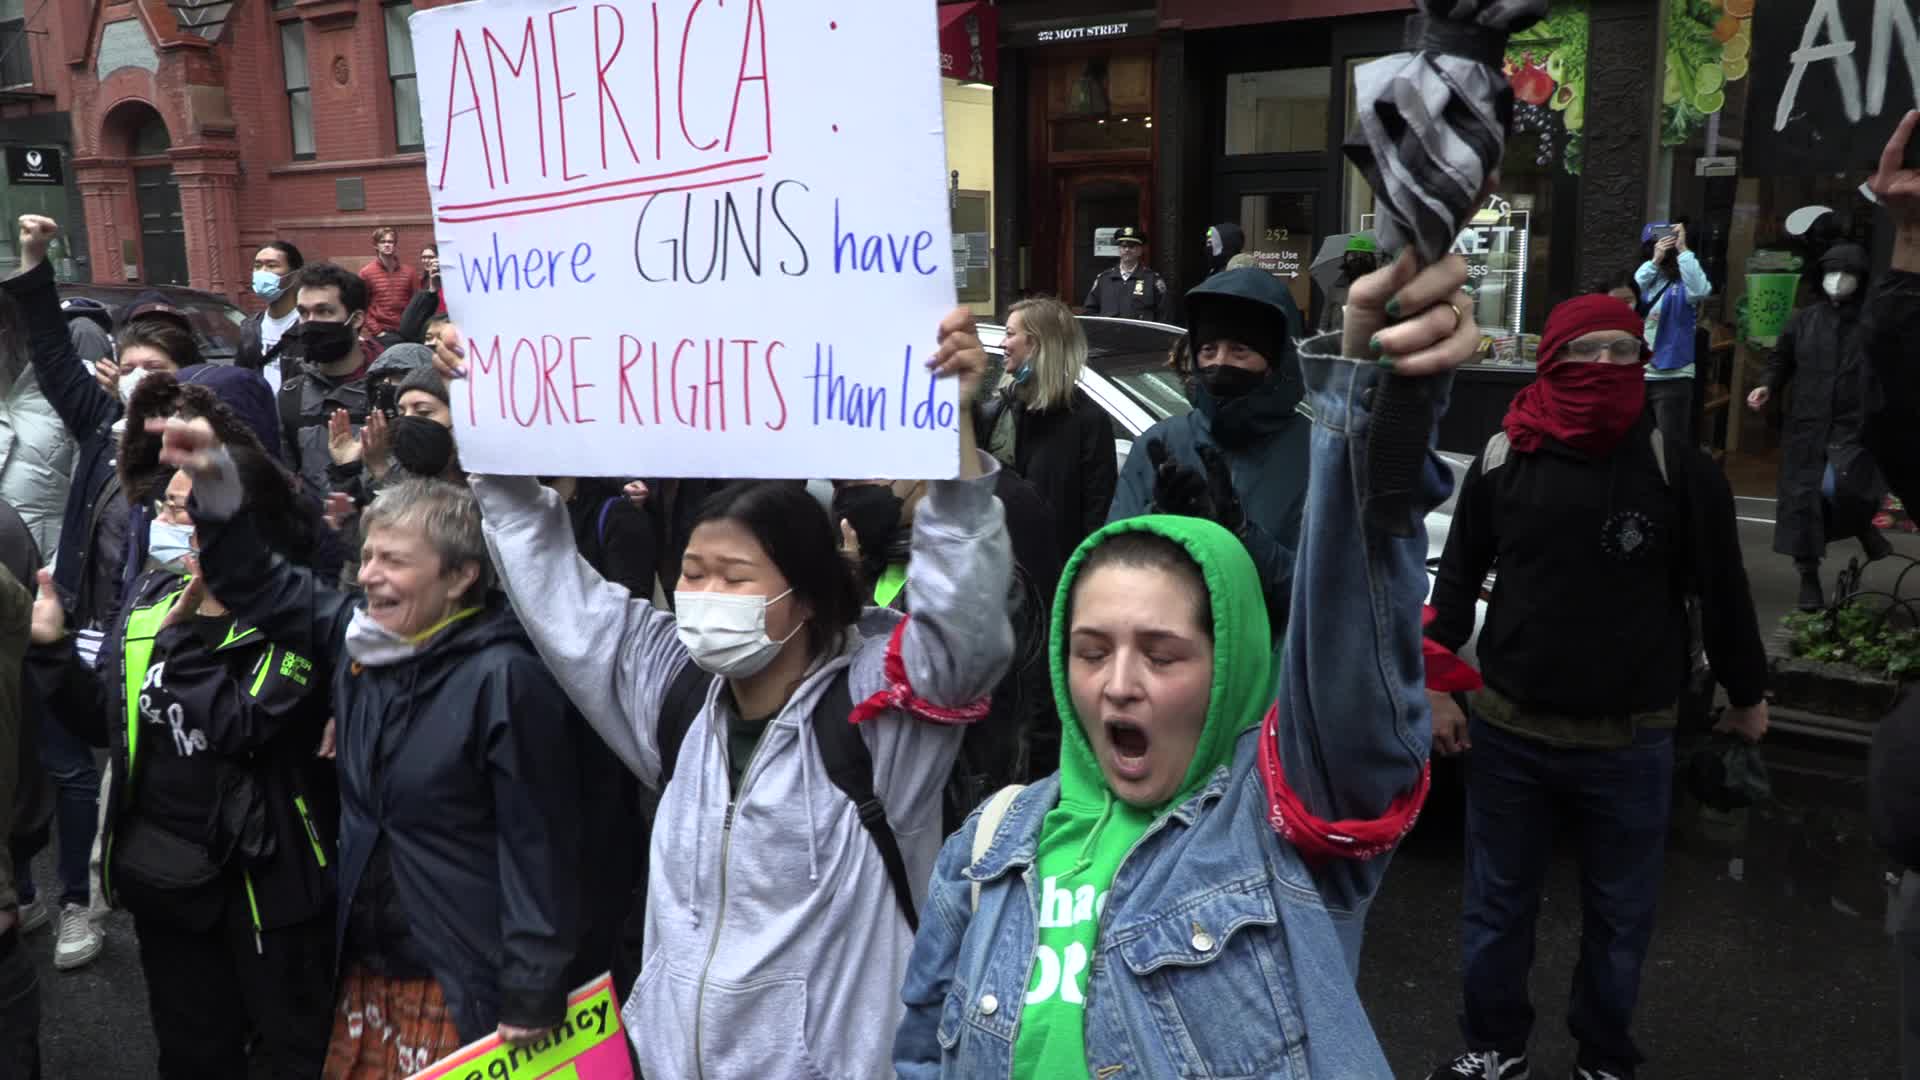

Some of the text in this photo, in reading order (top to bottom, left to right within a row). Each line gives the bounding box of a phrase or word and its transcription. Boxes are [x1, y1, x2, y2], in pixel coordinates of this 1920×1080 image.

[1055, 27, 1086, 39] MOTT
[1087, 23, 1129, 37] STREET
[459, 232, 597, 294] where
[634, 179, 810, 285] GUNS
[832, 198, 938, 276] have
[1264, 228, 1289, 241] 252
[1253, 250, 1299, 260] Please Use
[1277, 261, 1300, 270] Door
[467, 335, 597, 428] MORE
[618, 334, 788, 432] RIGHTS
[802, 341, 886, 432] than
[901, 344, 912, 427] I
